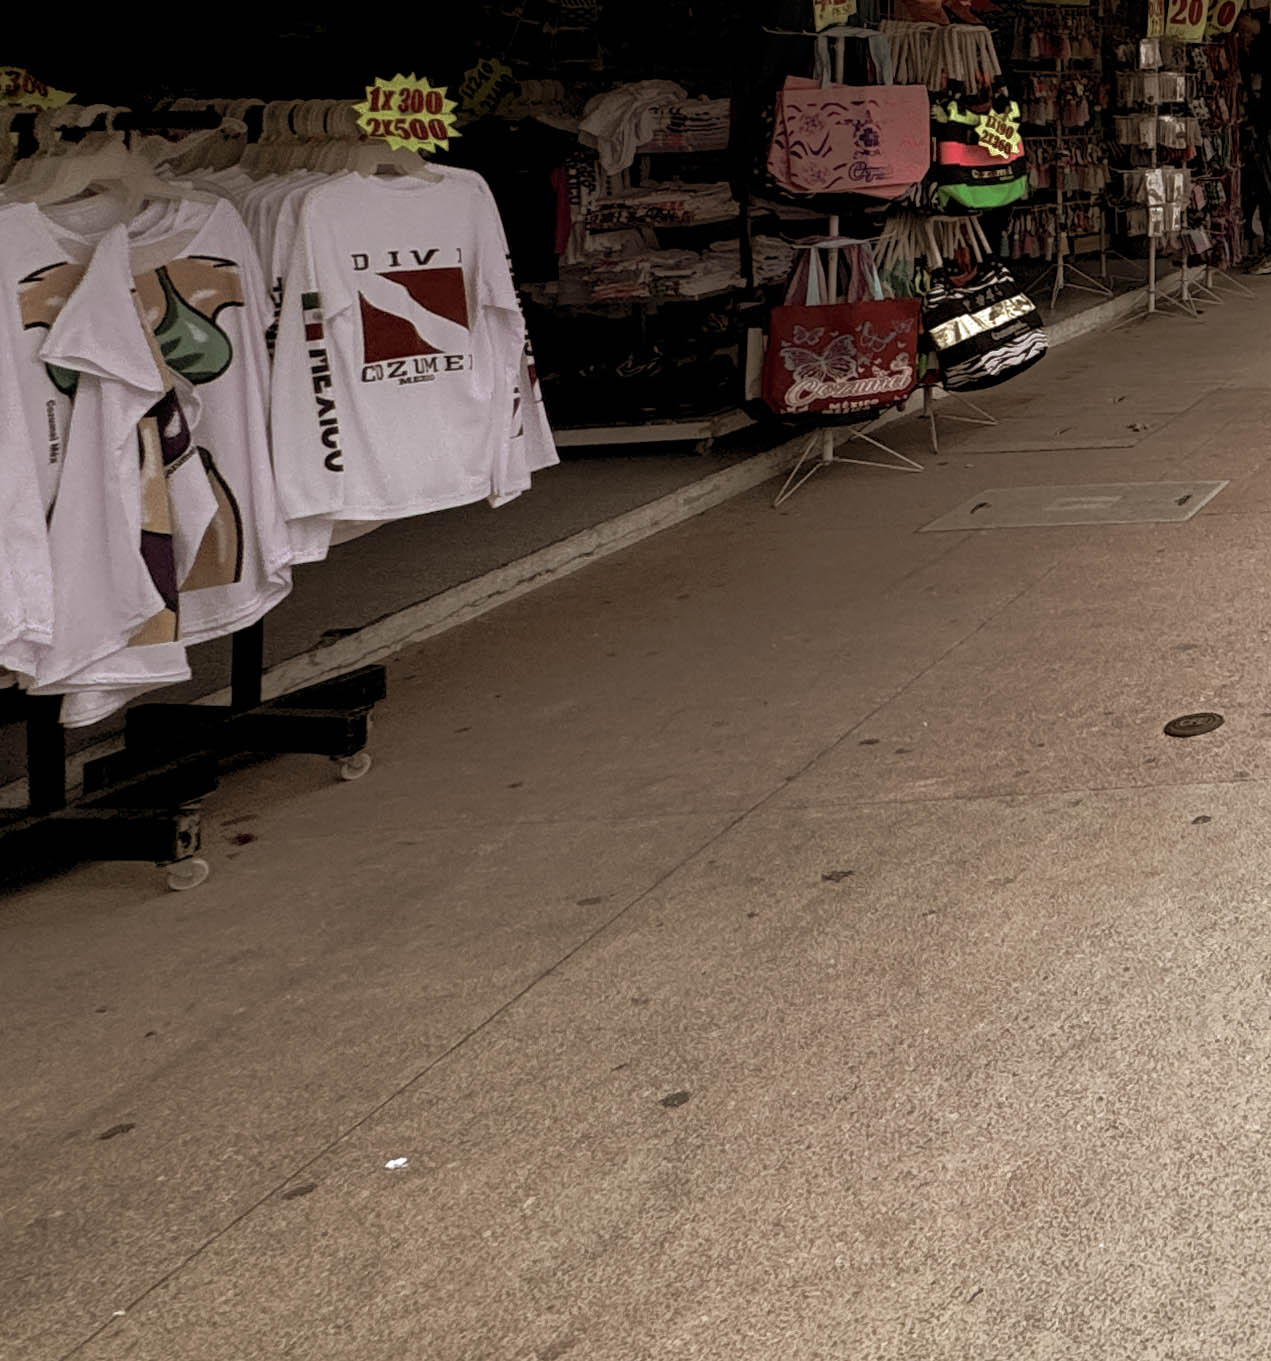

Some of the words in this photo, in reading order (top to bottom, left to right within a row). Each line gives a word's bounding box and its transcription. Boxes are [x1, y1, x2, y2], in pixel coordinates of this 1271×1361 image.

[351, 248, 462, 271] DIV
[361, 354, 473, 384] COZUME
[784, 367, 912, 409] Cozumel
